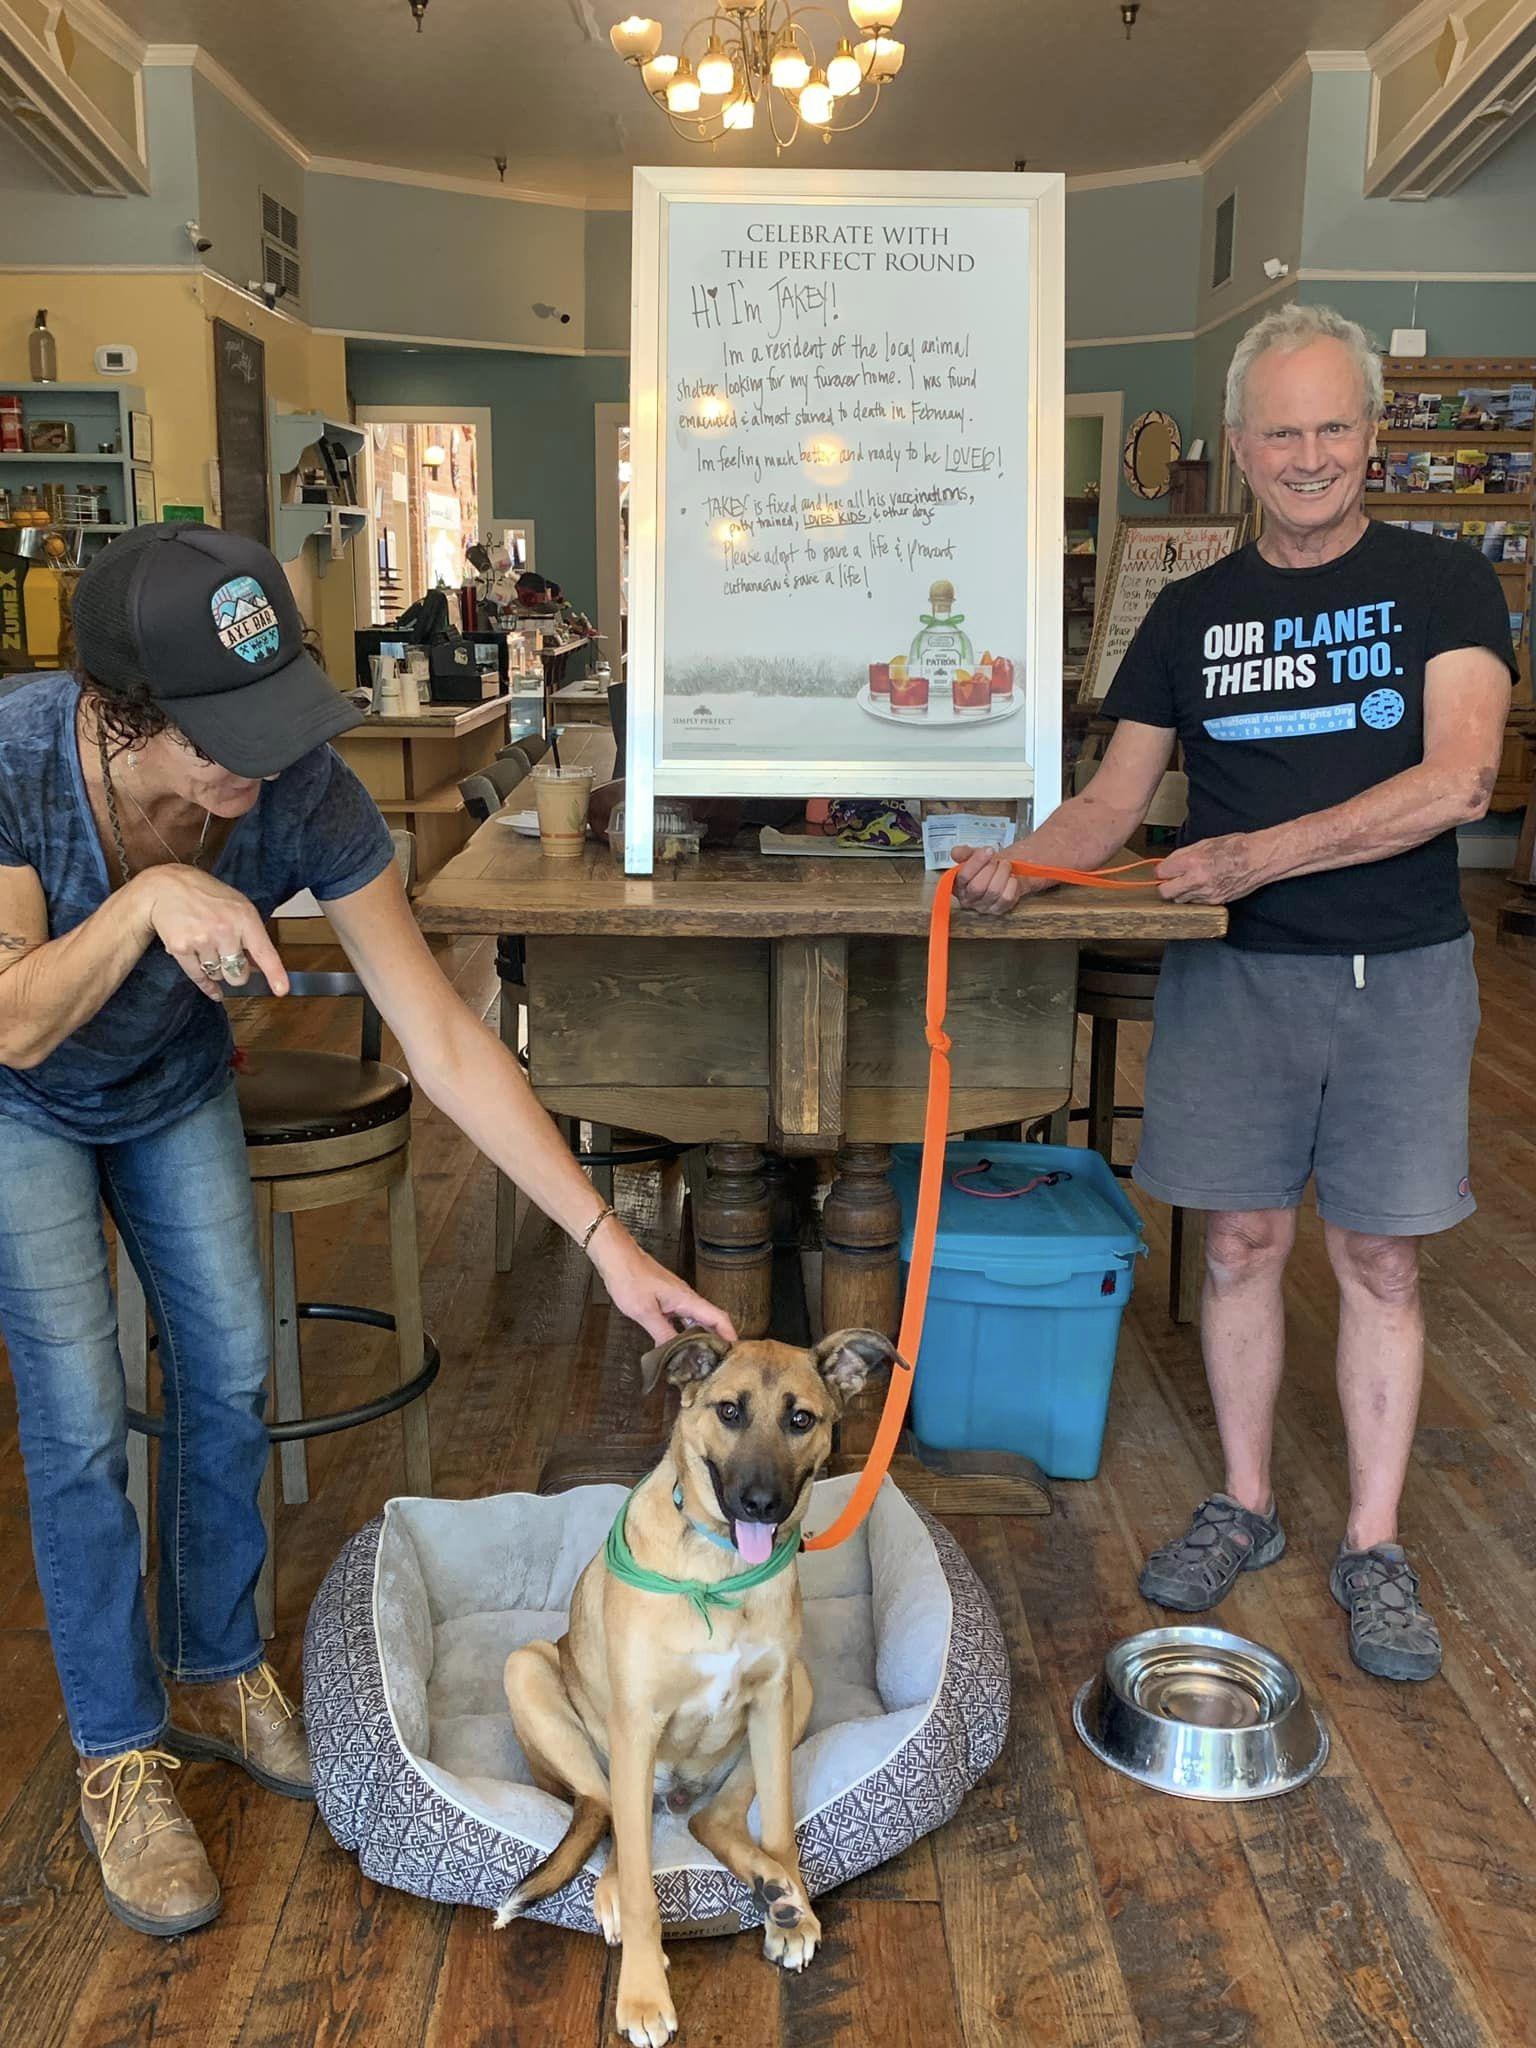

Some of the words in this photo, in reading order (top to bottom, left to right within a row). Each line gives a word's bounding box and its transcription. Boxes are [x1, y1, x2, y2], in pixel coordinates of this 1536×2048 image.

[747, 224, 873, 244] CELEBRATE
[882, 226, 949, 245] WITH
[721, 250, 769, 269] THE
[779, 251, 876, 271] PERFECT
[886, 253, 976, 272] ROUND
[692, 284, 721, 329] Hi
[728, 279, 762, 325] I'm
[768, 276, 839, 340] JAKEY!
[752, 348, 763, 363] a
[766, 336, 827, 360] resident
[832, 335, 846, 356] of
[852, 334, 878, 359] the
[885, 331, 915, 362] local
[921, 333, 970, 358] animal
[725, 373, 764, 411] looking
[766, 366, 785, 391] for
[790, 374, 808, 406] my
[861, 362, 901, 386] home.
[910, 365, 915, 390] I
[923, 374, 942, 391] was
[947, 366, 977, 390] found
[751, 406, 790, 427] almost
[795, 408, 834, 426] starved
[838, 402, 847, 422] to
[853, 400, 887, 422] death
[891, 400, 906, 420] in
[717, 445, 762, 484] feeling
[765, 449, 798, 468] much
[840, 441, 864, 463] and
[868, 441, 901, 473] ready
[906, 441, 918, 460] to
[924, 441, 942, 464] be
[702, 494, 751, 523] JAKEY
[754, 499, 763, 515] is
[766, 493, 798, 515] fixed
[801, 492, 822, 511] and
[847, 489, 864, 509] all
[868, 488, 886, 507] his
[803, 513, 834, 528] LOVES
[883, 507, 909, 518] other
[912, 504, 935, 526] dogs
[724, 539, 761, 571] Please
[764, 543, 800, 573] adopt
[805, 538, 817, 561] to
[823, 546, 849, 562] save
[853, 546, 862, 559] a
[869, 532, 889, 559] life
[1127, 542, 1163, 561] Local
[793, 574, 820, 590] save
[825, 571, 834, 584] a
[839, 566, 873, 599] life!
[0, 568, 21, 650] ZUMEX
[226, 620, 252, 646] AXE
[252, 609, 274, 631] BAR
[1203, 621, 1264, 661] OUR
[1274, 601, 1403, 652] PLANET.
[1202, 653, 1317, 699] THEIRS
[1326, 641, 1404, 684] TOO.
[1221, 716, 1261, 728] National
[1263, 713, 1297, 724] Animal
[1300, 709, 1332, 720] Rights
[1334, 706, 1353, 717] Day
